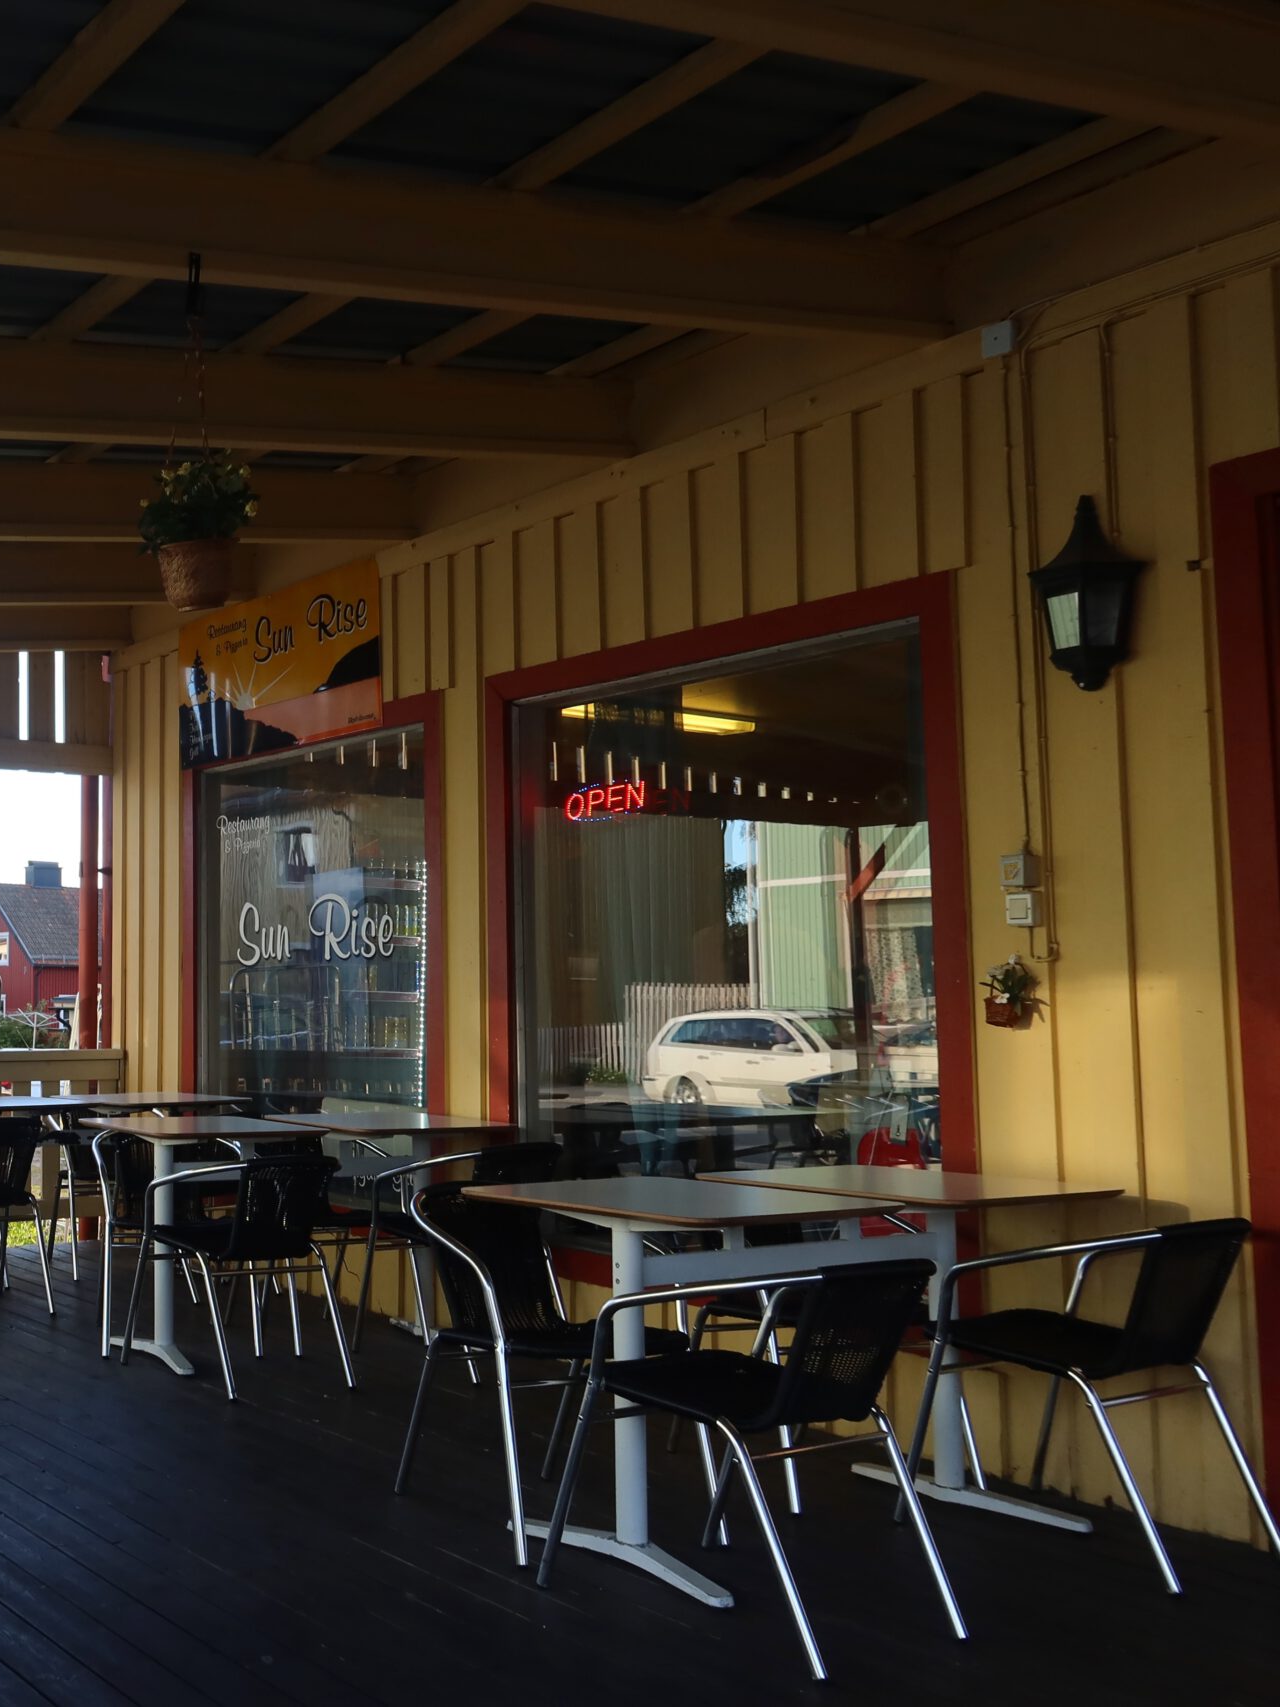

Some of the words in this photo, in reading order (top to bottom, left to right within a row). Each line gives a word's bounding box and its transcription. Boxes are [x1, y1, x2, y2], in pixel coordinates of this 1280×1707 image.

[253, 616, 295, 665] Sun
[306, 594, 368, 644] Rise
[215, 814, 270, 837] Restaurang
[564, 779, 646, 821] OPEN
[237, 902, 291, 966] Sun
[308, 893, 394, 961] Rise
